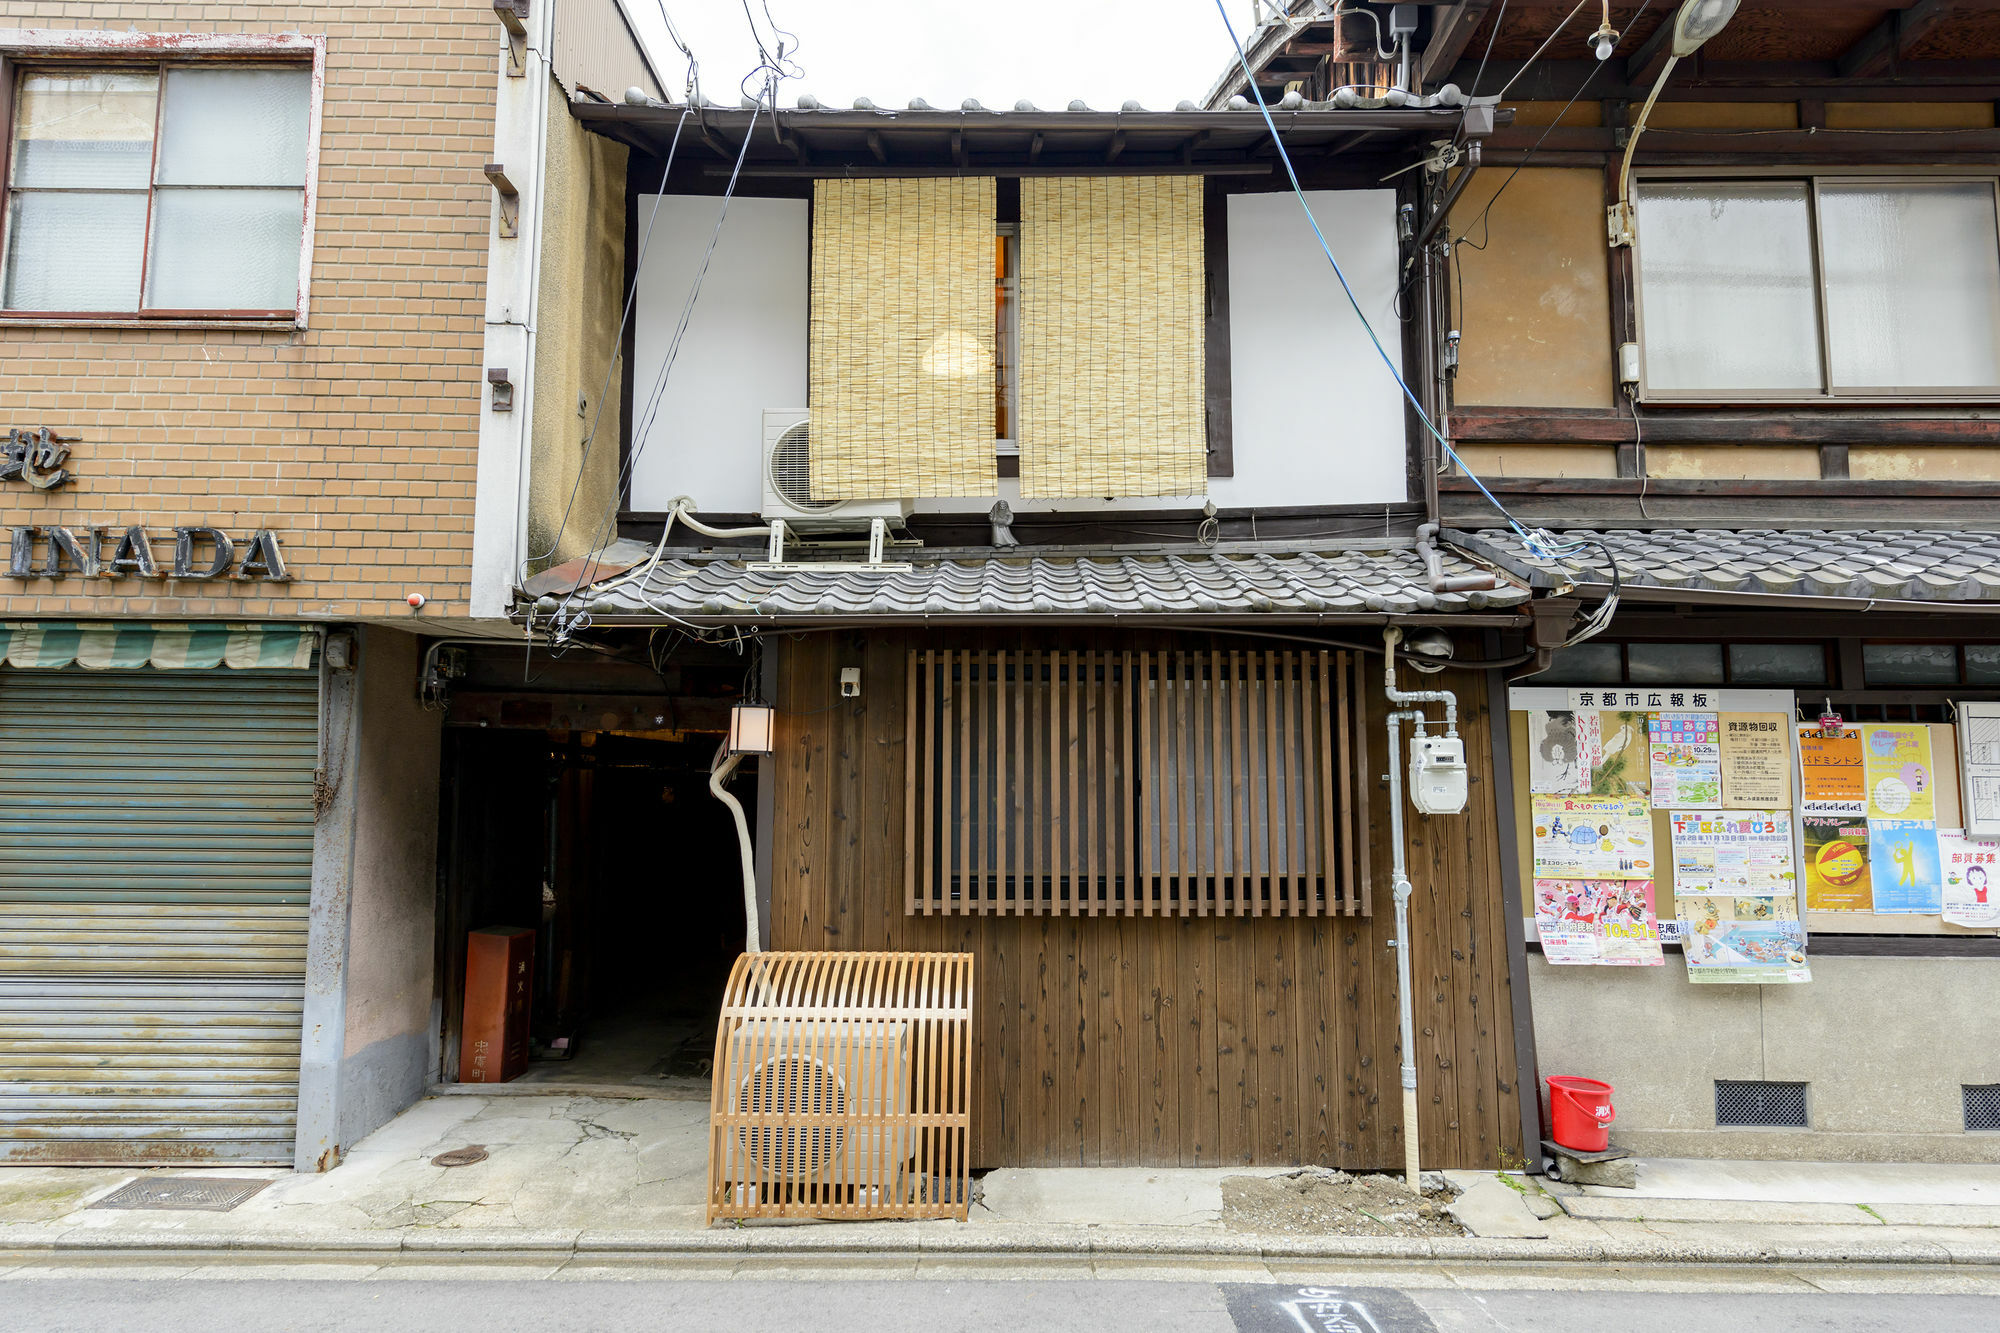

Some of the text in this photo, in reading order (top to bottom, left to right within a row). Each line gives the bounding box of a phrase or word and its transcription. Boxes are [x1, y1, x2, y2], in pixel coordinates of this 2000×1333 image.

[3, 525, 293, 582] INADA
[1579, 692, 1708, 708] 京都市広報板
[1728, 722, 1778, 732] 資源物回収
[1589, 715, 1602, 767] 若冲の京都
[1802, 756, 1863, 765] バドミントン
[1673, 821, 1788, 834] 下京区ふれ愛ひろば
[1951, 852, 1997, 864] 部員募集
[1603, 923, 1658, 938] 10月31日
[1657, 924, 1680, 935] 忠庵
[472, 1040, 489, 1082] 忠庵町
